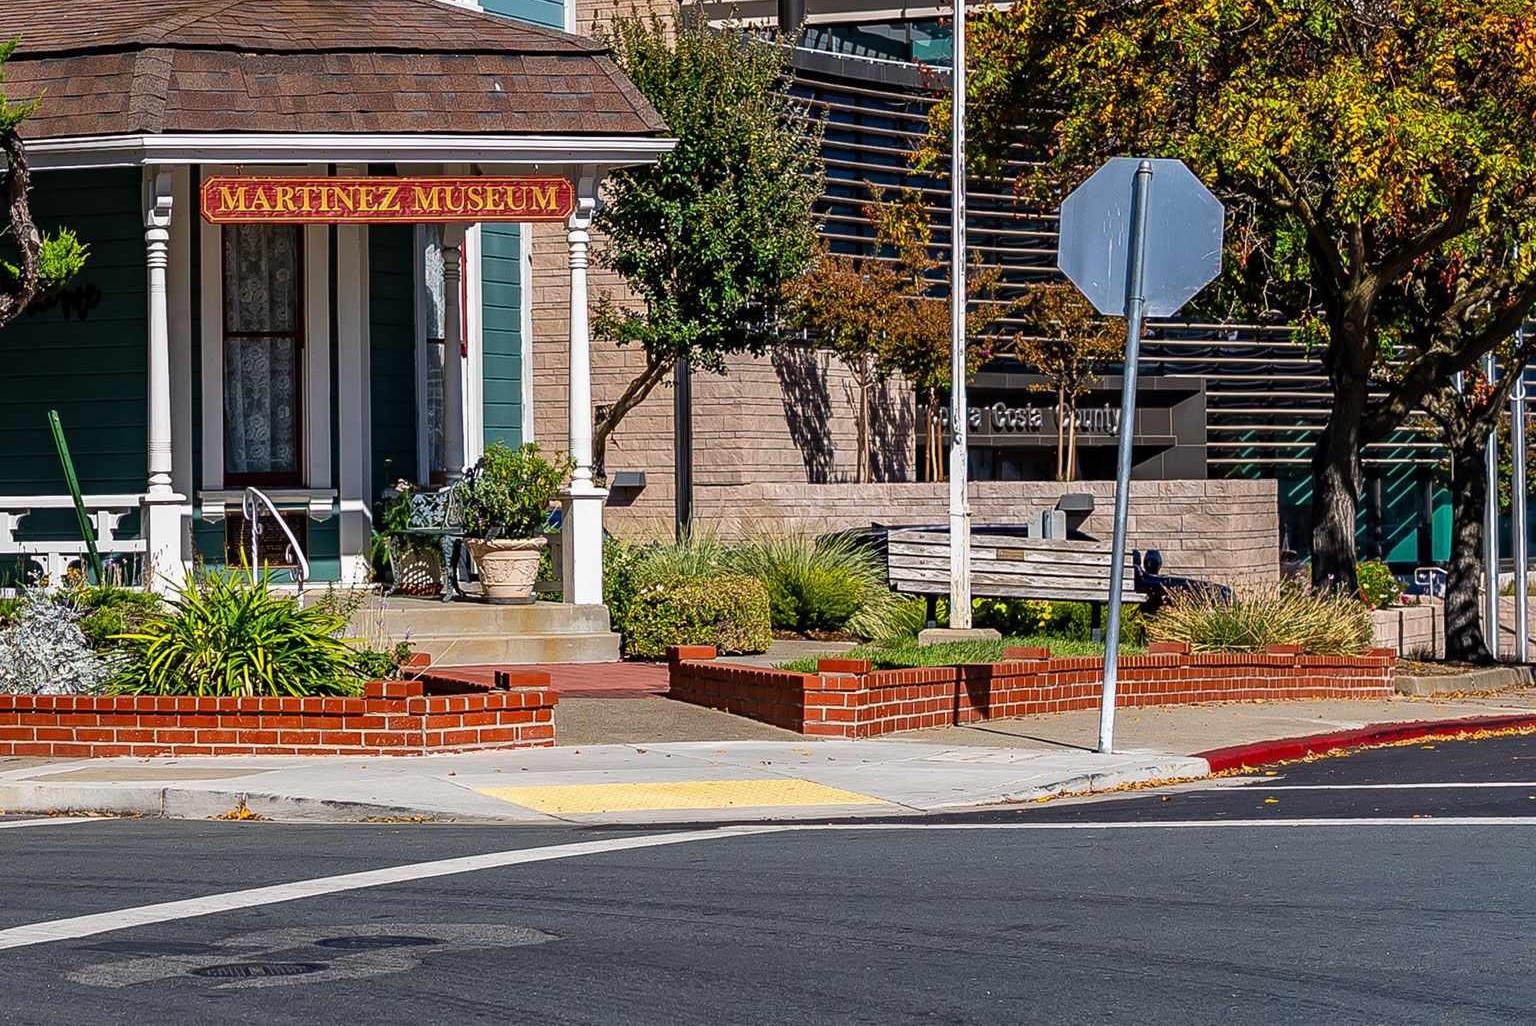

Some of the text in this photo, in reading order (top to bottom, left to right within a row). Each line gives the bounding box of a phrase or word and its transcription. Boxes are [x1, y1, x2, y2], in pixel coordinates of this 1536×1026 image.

[218, 186, 559, 212] MARTINEZ MUSEUM
[992, 401, 1044, 428] Costa
